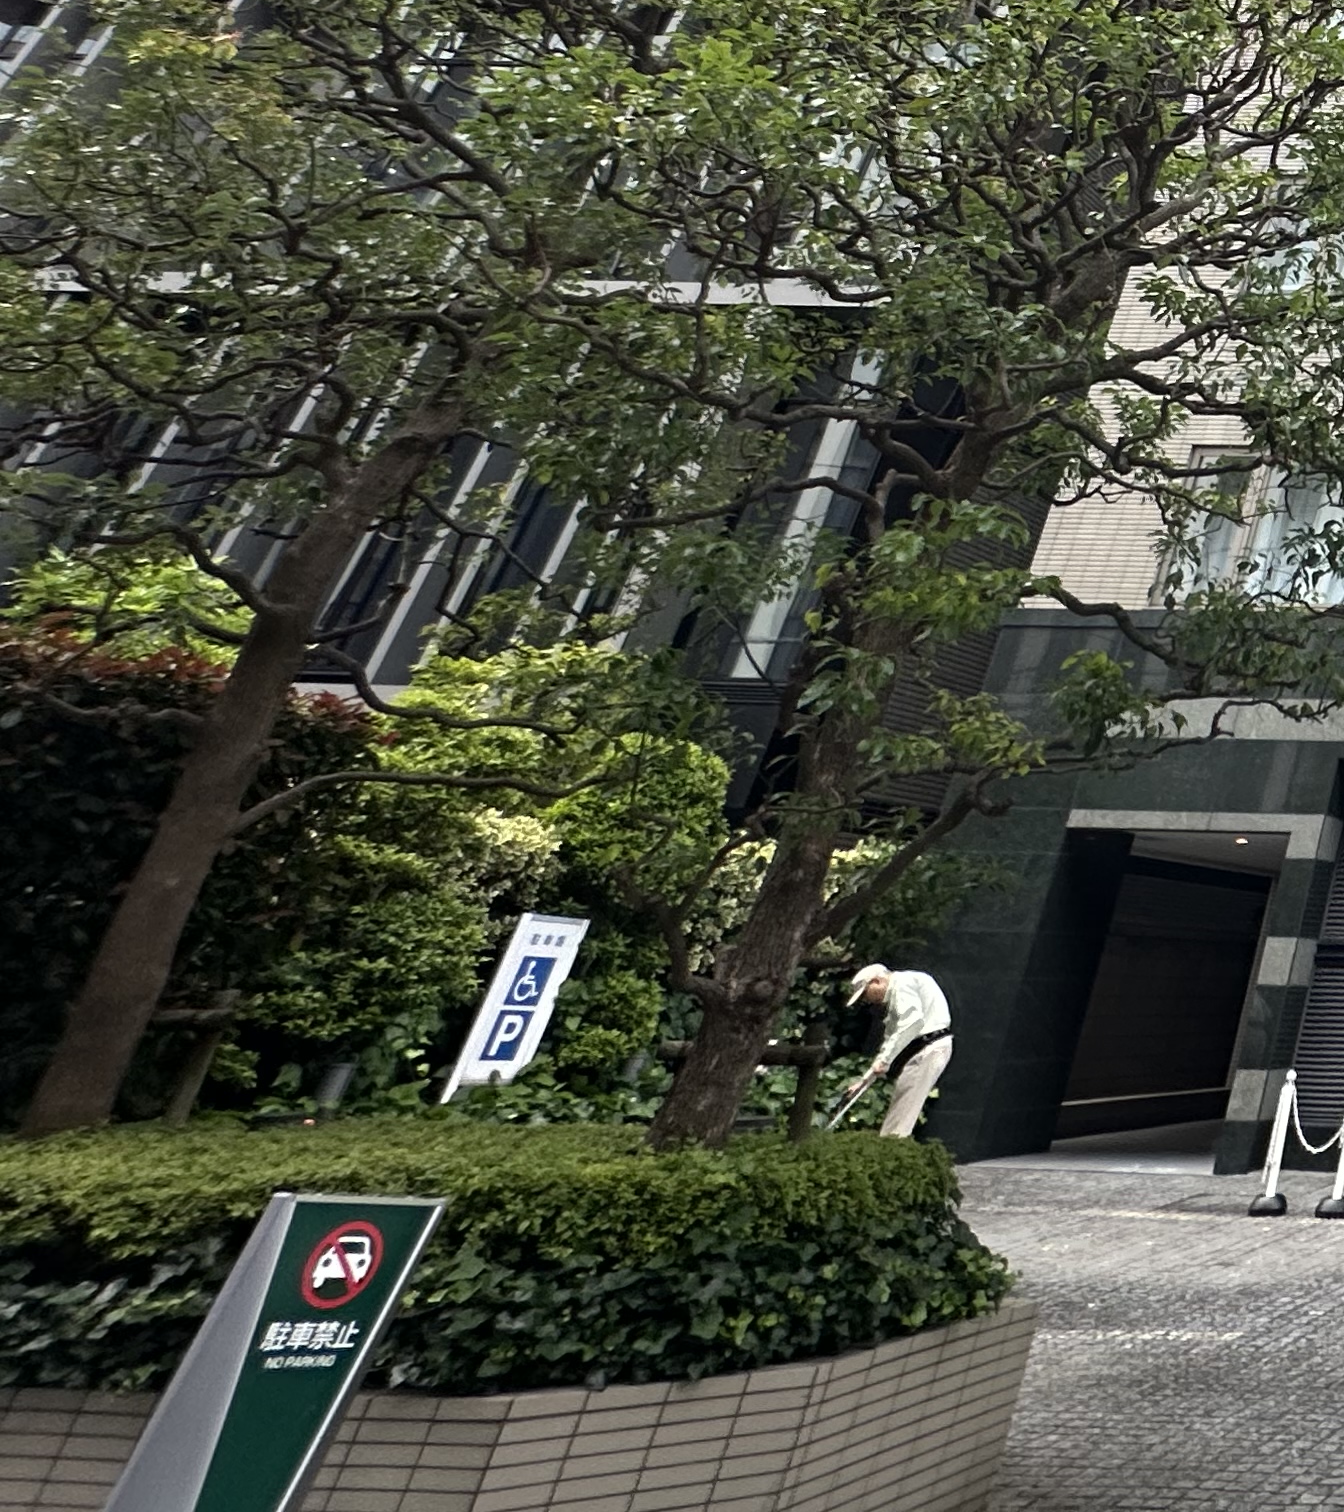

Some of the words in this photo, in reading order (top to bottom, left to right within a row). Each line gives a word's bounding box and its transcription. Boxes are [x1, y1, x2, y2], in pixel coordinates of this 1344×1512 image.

[488, 1014, 524, 1056] P
[259, 1320, 360, 1352] 駐車禁止
[264, 1357, 285, 1369] NO
